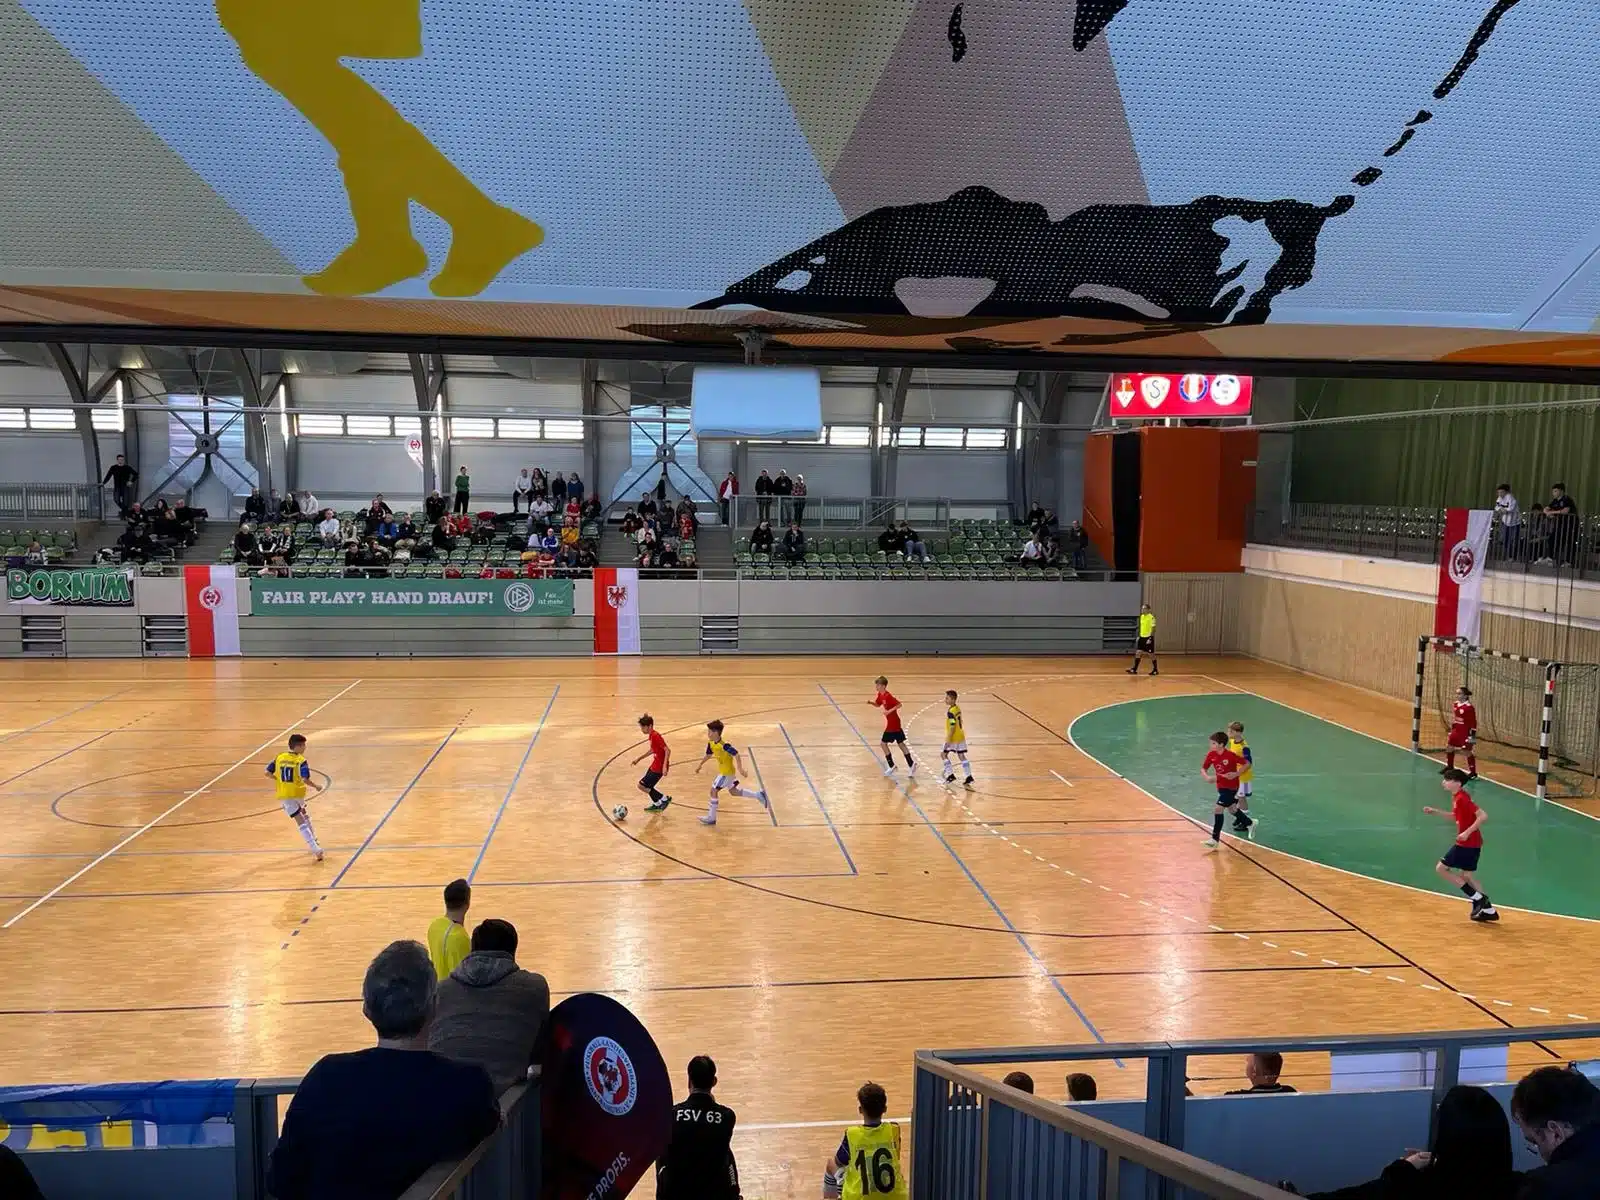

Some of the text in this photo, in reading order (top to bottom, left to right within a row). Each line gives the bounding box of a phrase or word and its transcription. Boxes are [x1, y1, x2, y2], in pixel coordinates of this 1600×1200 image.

[8, 568, 131, 602] BORNIM
[262, 591, 493, 604] FAIR PLAY? HAND DRAUF!
[280, 766, 294, 783] 10
[676, 1109, 722, 1124] FSV 63
[595, 1151, 631, 1198] PROFIS.
[855, 1147, 896, 1196] 16
